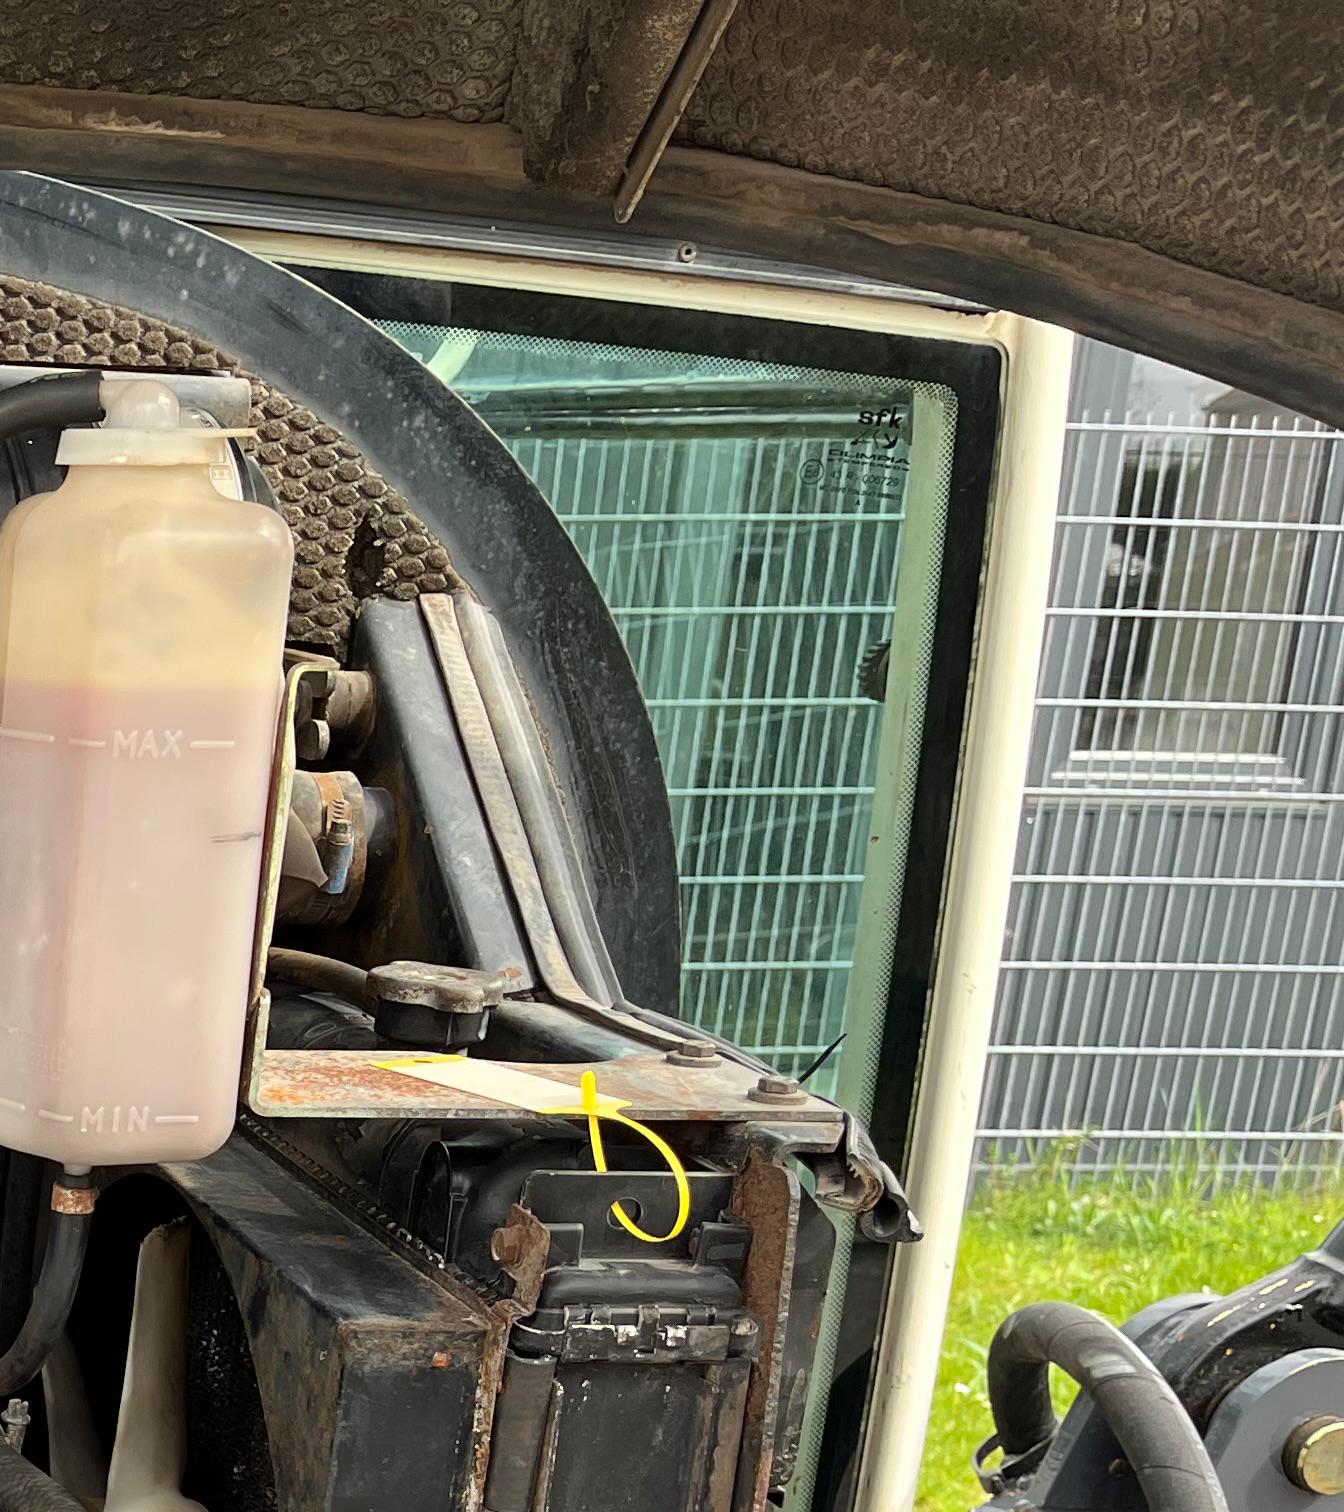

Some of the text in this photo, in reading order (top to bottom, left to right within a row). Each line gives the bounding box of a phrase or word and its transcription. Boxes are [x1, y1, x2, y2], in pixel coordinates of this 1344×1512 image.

[858, 406, 903, 429] sfk
[112, 729, 183, 759] MAX
[80, 1105, 150, 1133] MIN
